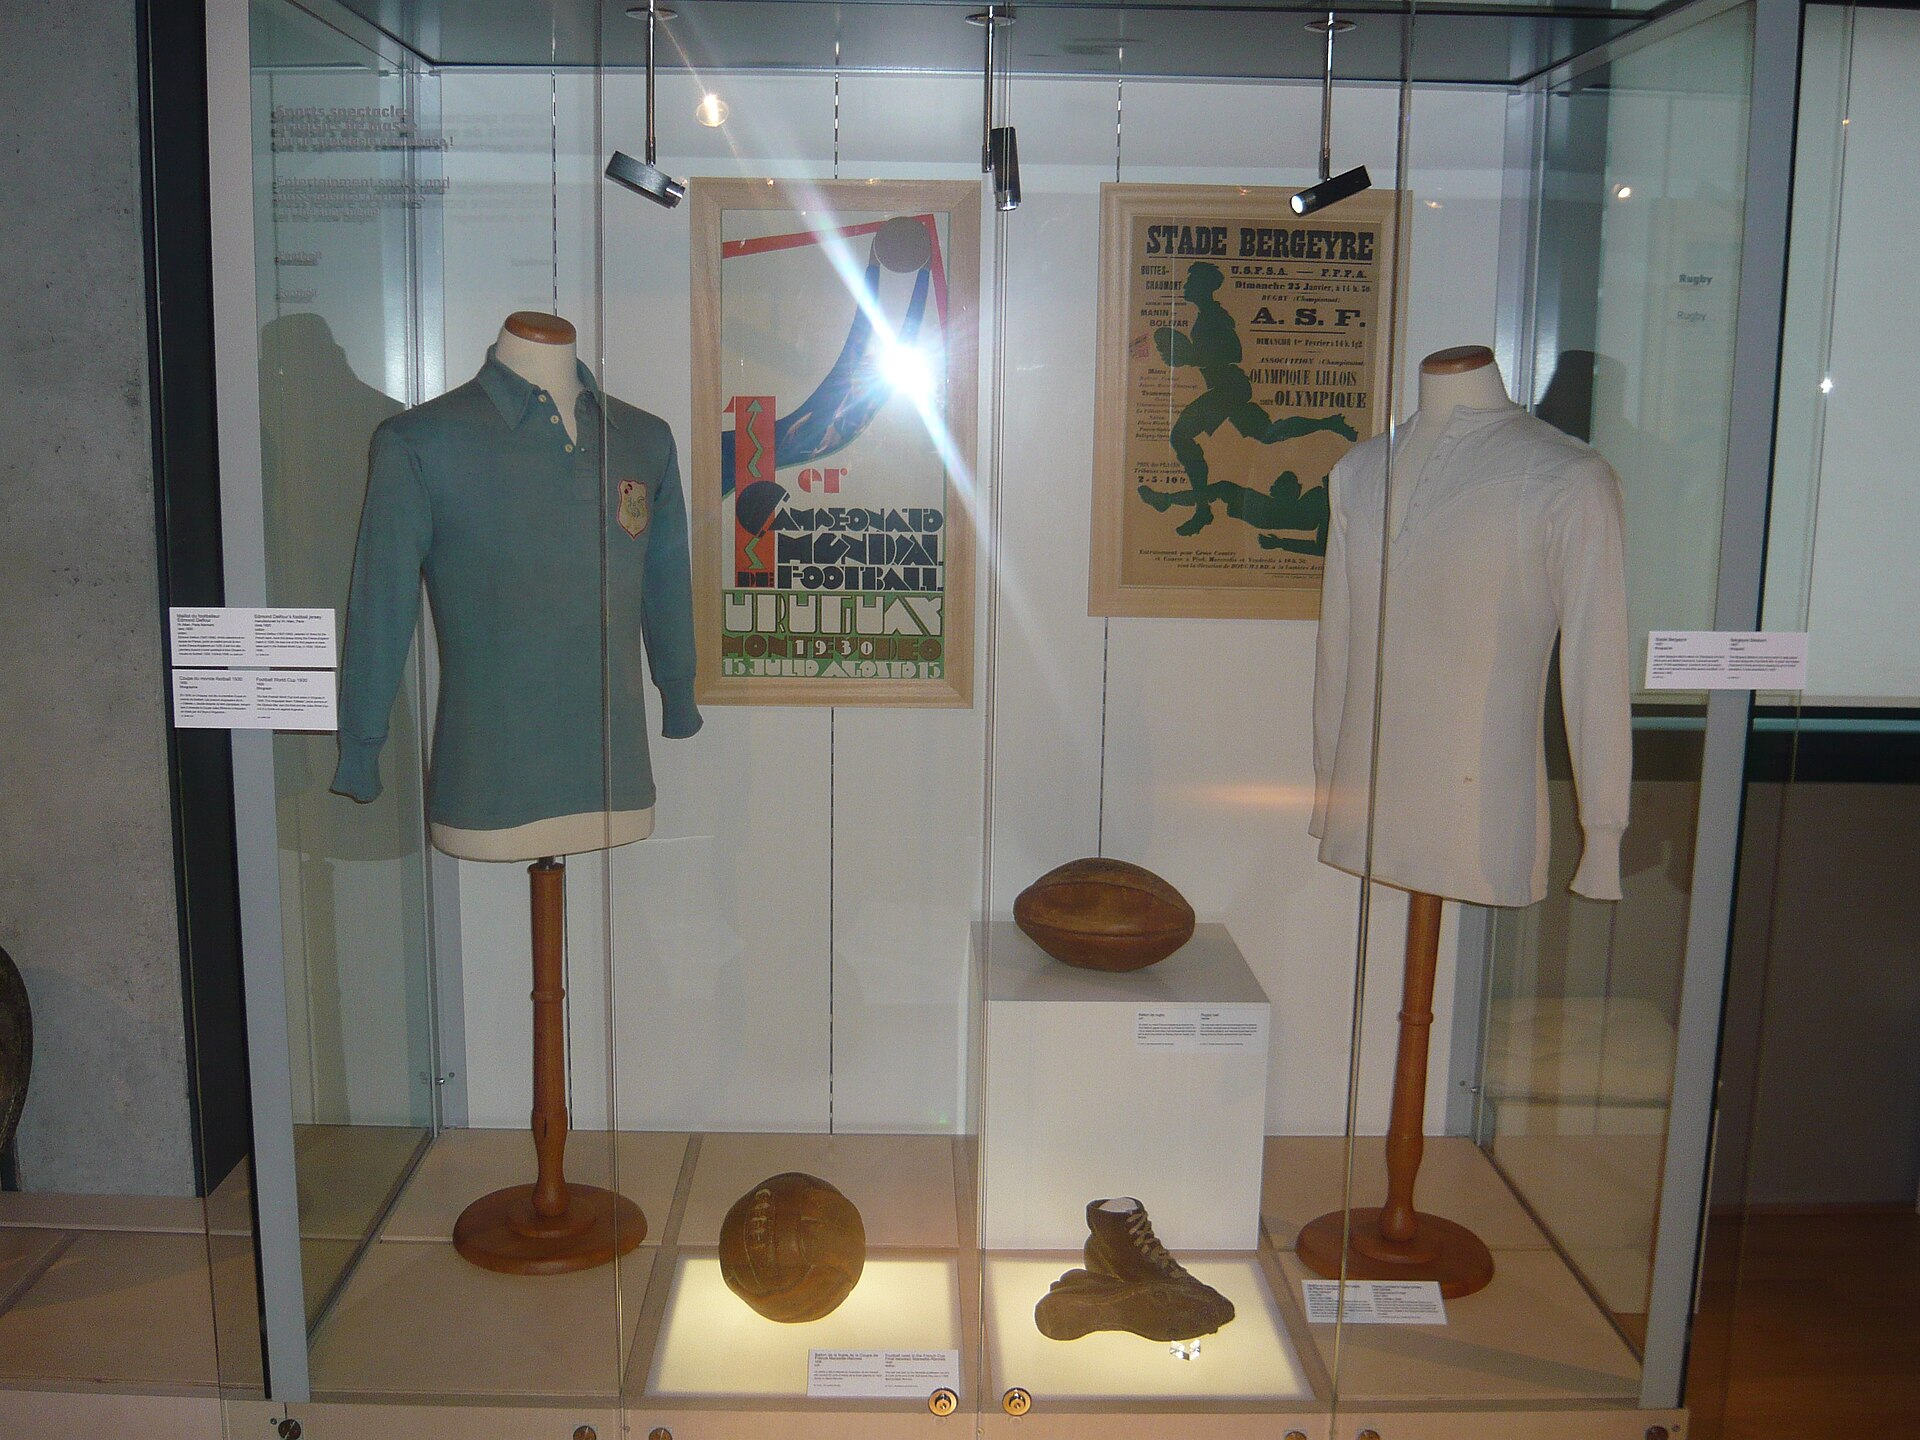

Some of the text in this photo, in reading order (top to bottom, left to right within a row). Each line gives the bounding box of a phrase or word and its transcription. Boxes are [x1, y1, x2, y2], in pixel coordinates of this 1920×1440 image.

[1146, 225, 1374, 261] STADE BERGEYRE
[1235, 280, 1285, 291] Dimanche
[1679, 274, 1712, 285] Rugby
[1141, 309, 1169, 317] MANIN
[1677, 311, 1706, 322] Rugby
[1249, 368, 1357, 387] OLYMPIQUE LILLOIS
[1274, 390, 1367, 409] OLYMPIQUE
[777, 565, 944, 591] FOOTBALL
[723, 592, 943, 637] URUGUAY
